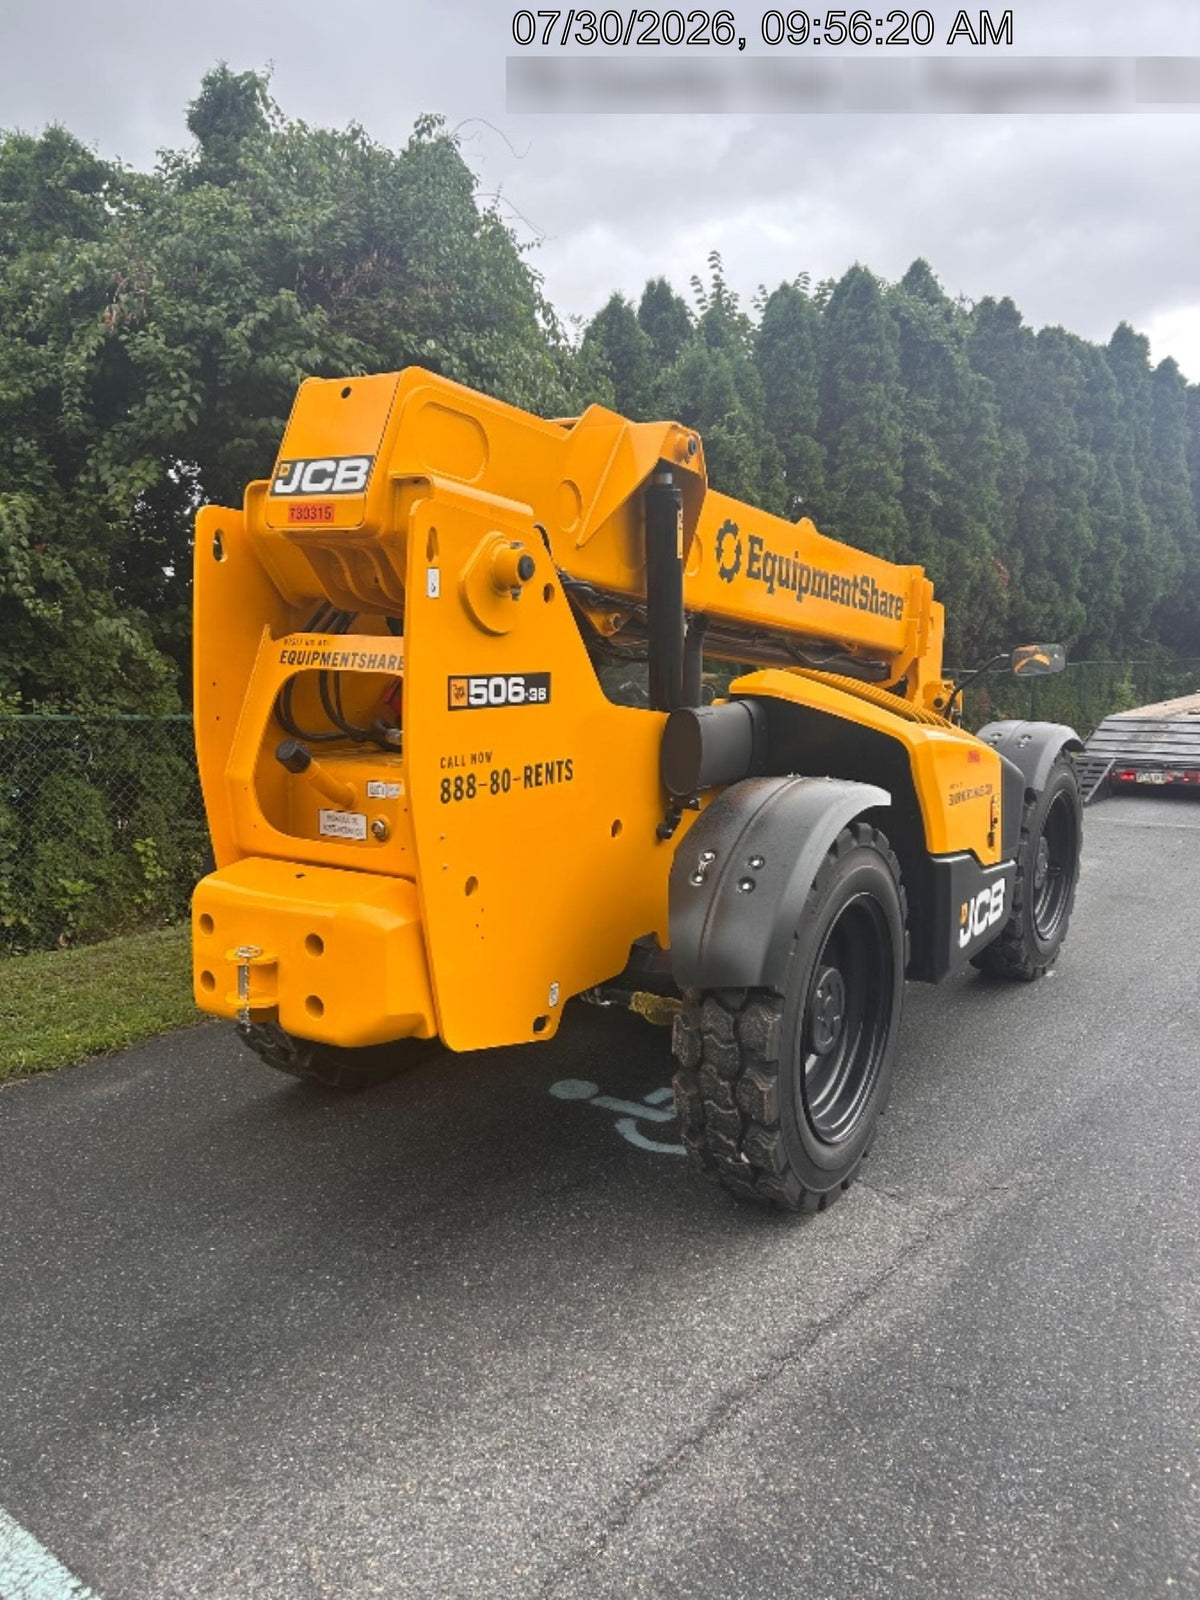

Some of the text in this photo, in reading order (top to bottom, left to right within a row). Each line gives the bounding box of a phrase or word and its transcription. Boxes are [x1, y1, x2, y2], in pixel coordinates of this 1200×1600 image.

[274, 457, 370, 494] JCB
[745, 533, 905, 622] EquipmentShare
[280, 649, 404, 671] EQUIPMENTSHARE
[440, 750, 493, 769] CALL NOW
[440, 758, 574, 804] 888-80-RENTS
[959, 877, 1006, 948] JCB
